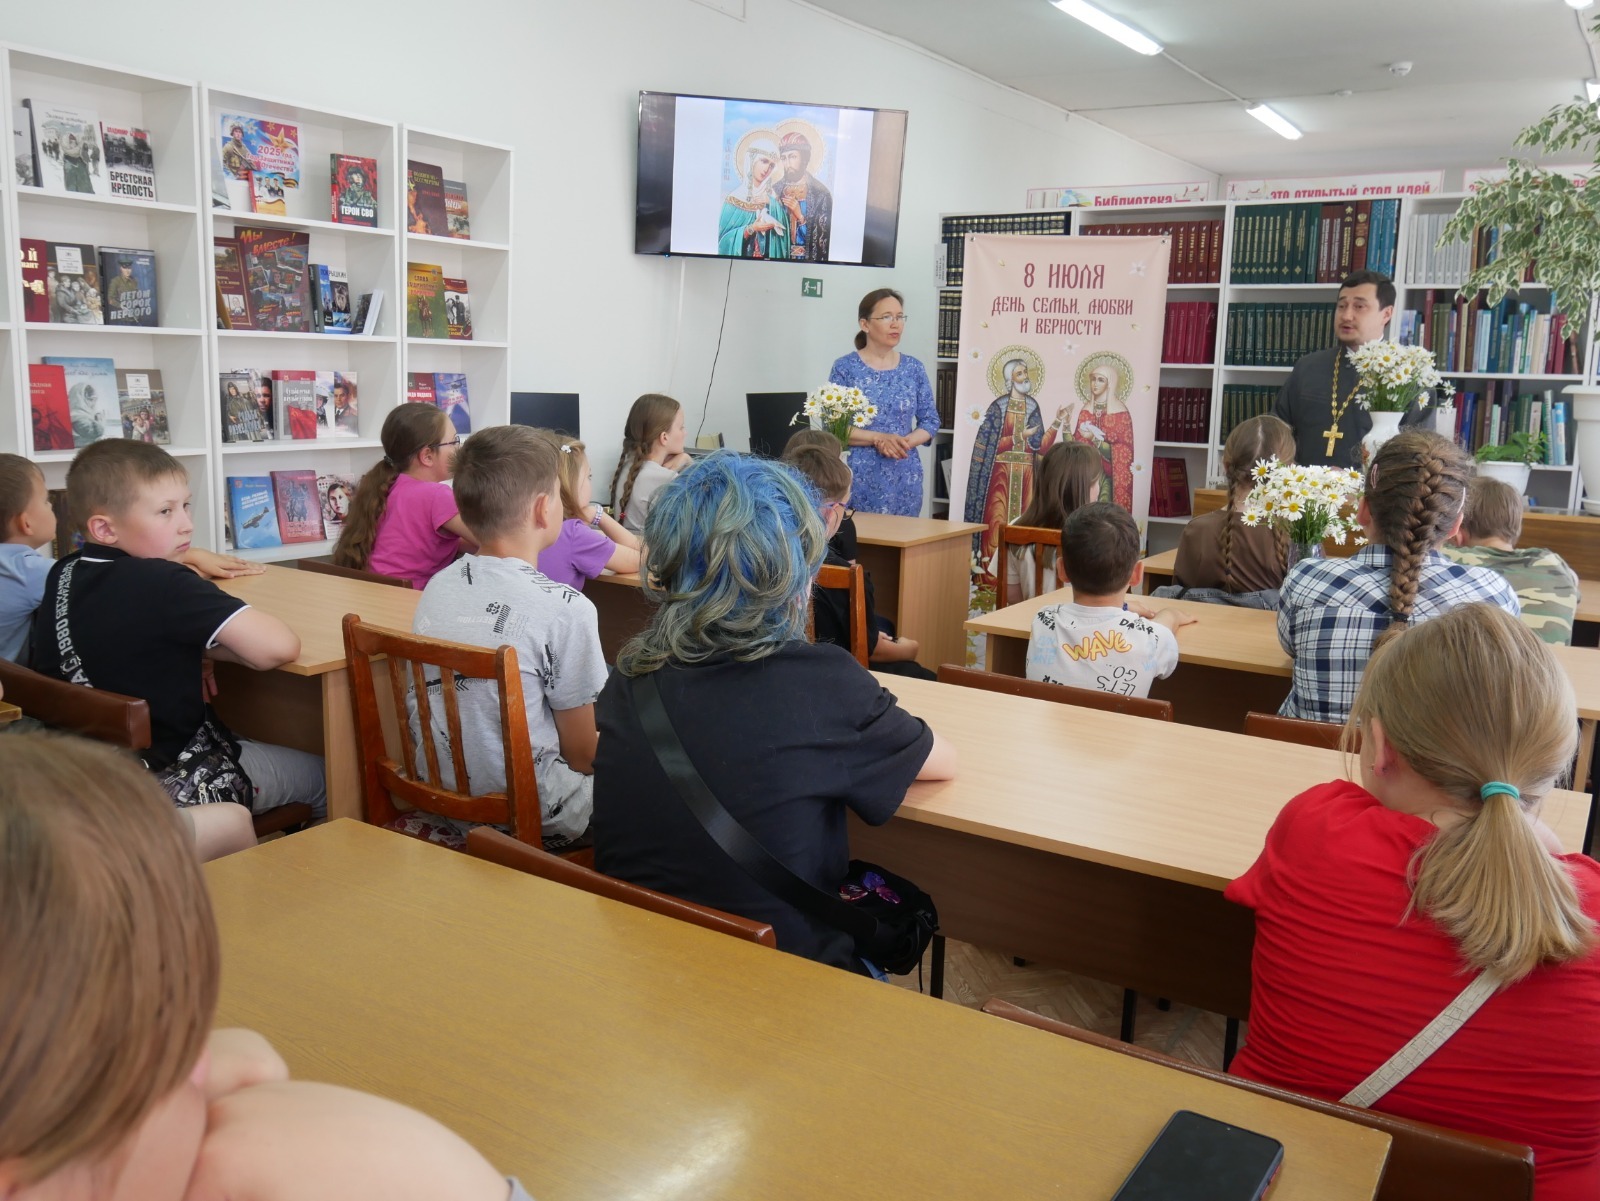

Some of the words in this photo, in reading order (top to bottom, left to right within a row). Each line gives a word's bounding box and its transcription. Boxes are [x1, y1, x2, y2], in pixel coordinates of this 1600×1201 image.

[257, 145, 281, 157] 2025
[259, 155, 295, 166] Защитника
[261, 162, 294, 173] Отечества
[109, 171, 153, 187] БРЕСТСКАЯ
[111, 182, 154, 198] КРЕПОСТЬ
[340, 205, 360, 217] ГЕРОИ
[361, 206, 374, 218] СВО
[239, 229, 264, 245] Мы
[1023, 262, 1036, 289] 8
[1048, 262, 1106, 290] ИЮЛЯ
[119, 289, 151, 301] ЛЕТОМ
[120, 298, 151, 310] СОРОК
[991, 296, 1026, 317] ДЕНЬ
[1033, 296, 1081, 316] СЕМЬИ,
[1087, 298, 1134, 317] ЛЮБВИ
[110, 306, 152, 320] ПЕРВОГО
[1019, 317, 1029, 335] И
[1035, 318, 1103, 336] ВЕРНОСТИ
[1062, 629, 1133, 662] WAVE
[1096, 675, 1137, 697] LET'S
